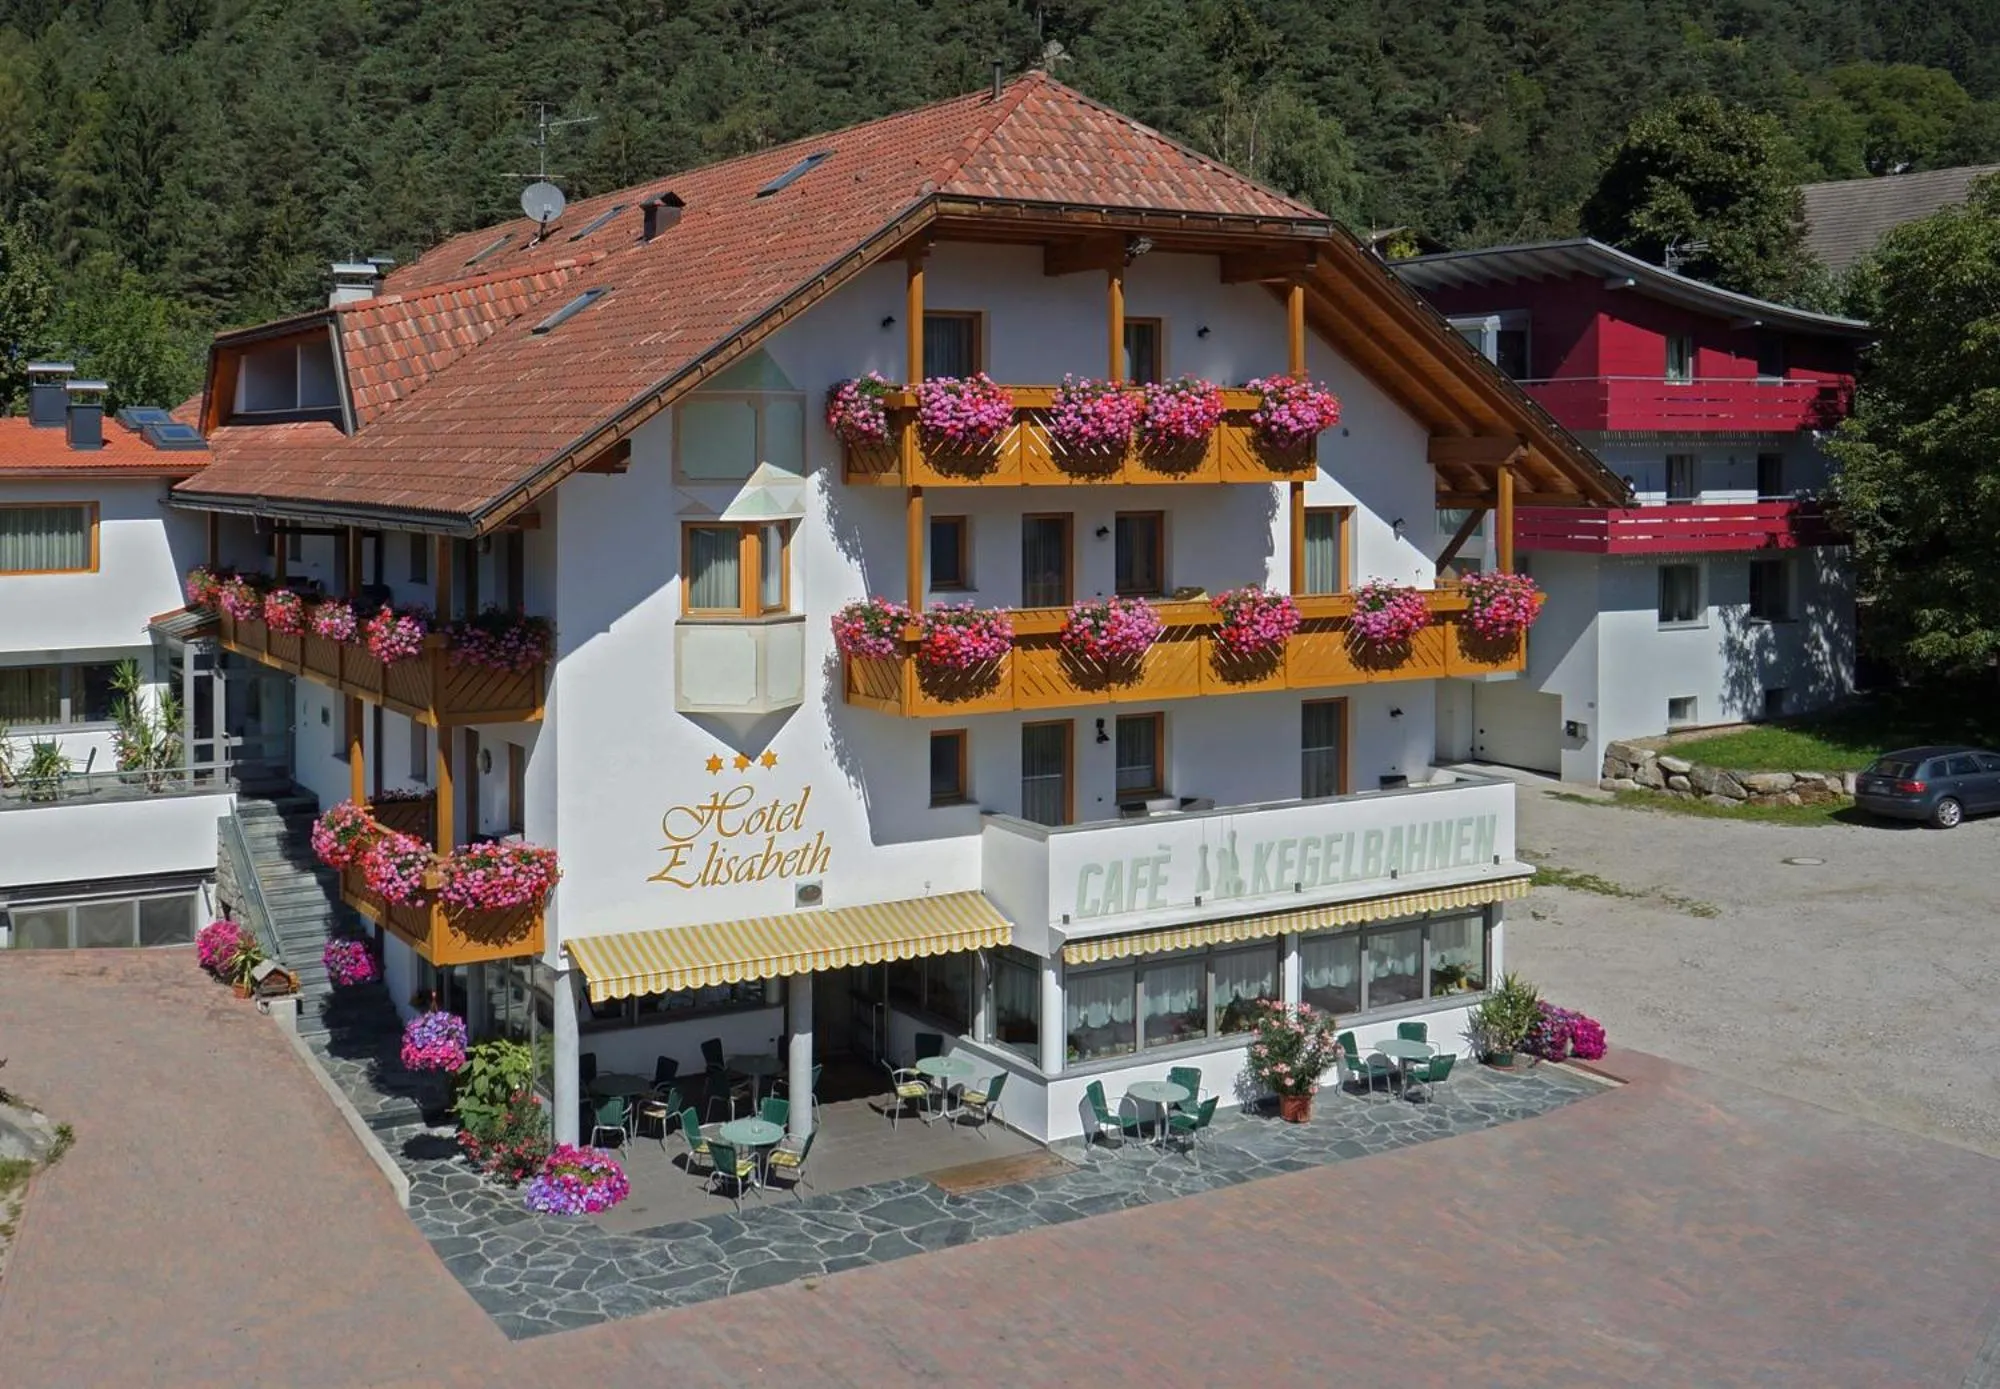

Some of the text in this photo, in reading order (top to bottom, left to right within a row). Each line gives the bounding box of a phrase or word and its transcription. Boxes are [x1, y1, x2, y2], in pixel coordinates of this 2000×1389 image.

[662, 785, 812, 842] Hotel
[646, 830, 832, 889] Elisabeth
[1251, 813, 1497, 895] KEGELBAHNEN
